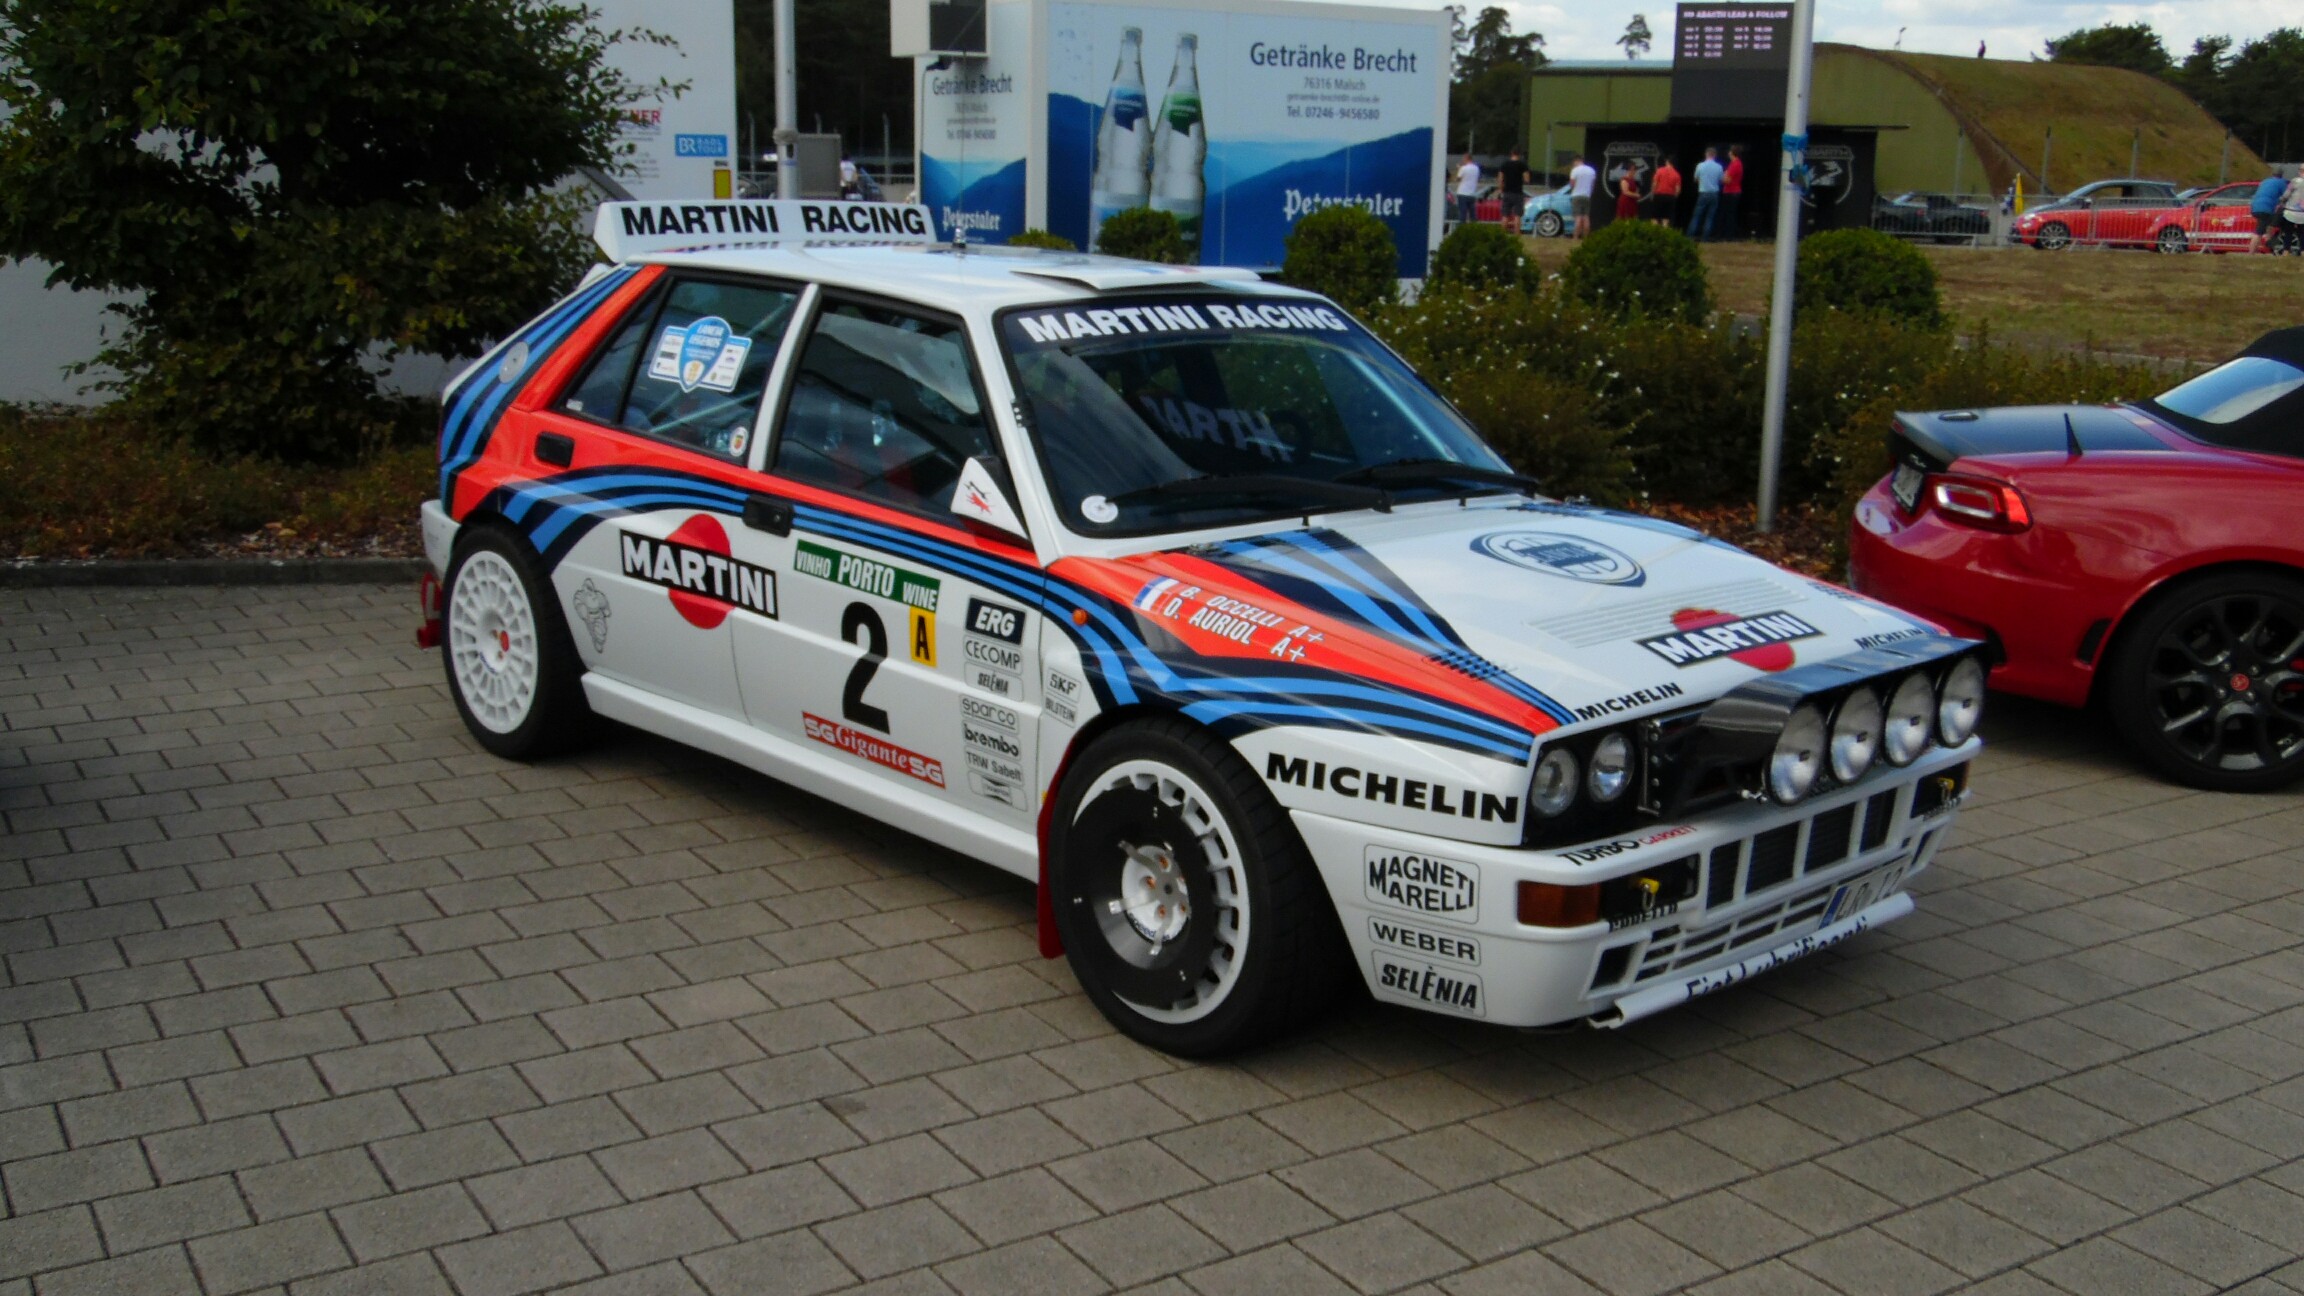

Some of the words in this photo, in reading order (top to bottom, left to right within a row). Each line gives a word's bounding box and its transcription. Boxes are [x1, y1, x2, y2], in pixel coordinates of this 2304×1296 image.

[1250, 42, 1345, 70] Getränke
[1353, 47, 1418, 73] Brecht
[979, 73, 1013, 94] Brecht
[1286, 106, 1303, 117] Tel.
[621, 206, 779, 236] MARTINI
[801, 205, 927, 235] RACING
[1018, 305, 1209, 342] MARTINI
[1210, 304, 1348, 331] RACING
[622, 535, 776, 615] MARTINI
[796, 550, 832, 579] VINHO
[837, 554, 895, 597] PORTO
[903, 581, 937, 611] WINE
[974, 605, 1016, 637] ERG
[1188, 607, 1258, 645] AURIOL
[1270, 636, 1306, 662] A+
[1206, 595, 1285, 628] OCCELLI
[1288, 625, 1324, 642] A+
[915, 615, 930, 661] A
[965, 640, 1020, 670] CECOMP
[1649, 613, 1814, 663] MARTINI
[1853, 626, 1927, 650] MICHELIN
[841, 601, 890, 735] 2
[1050, 673, 1077, 695] SKF
[962, 698, 1016, 726] sparco
[1575, 682, 1684, 722] MICHELIN
[836, 724, 908, 770] Gigante
[963, 723, 1019, 757] brembo
[966, 751, 988, 770] TRW
[1266, 752, 1519, 824] MICHELIN
[1556, 839, 1641, 866] TURBO
[1369, 856, 1475, 894] MAGNETI
[1369, 877, 1475, 912] MARELLI
[1373, 921, 1476, 961] WEBER
[1381, 963, 1478, 1010] SELÈNIA
